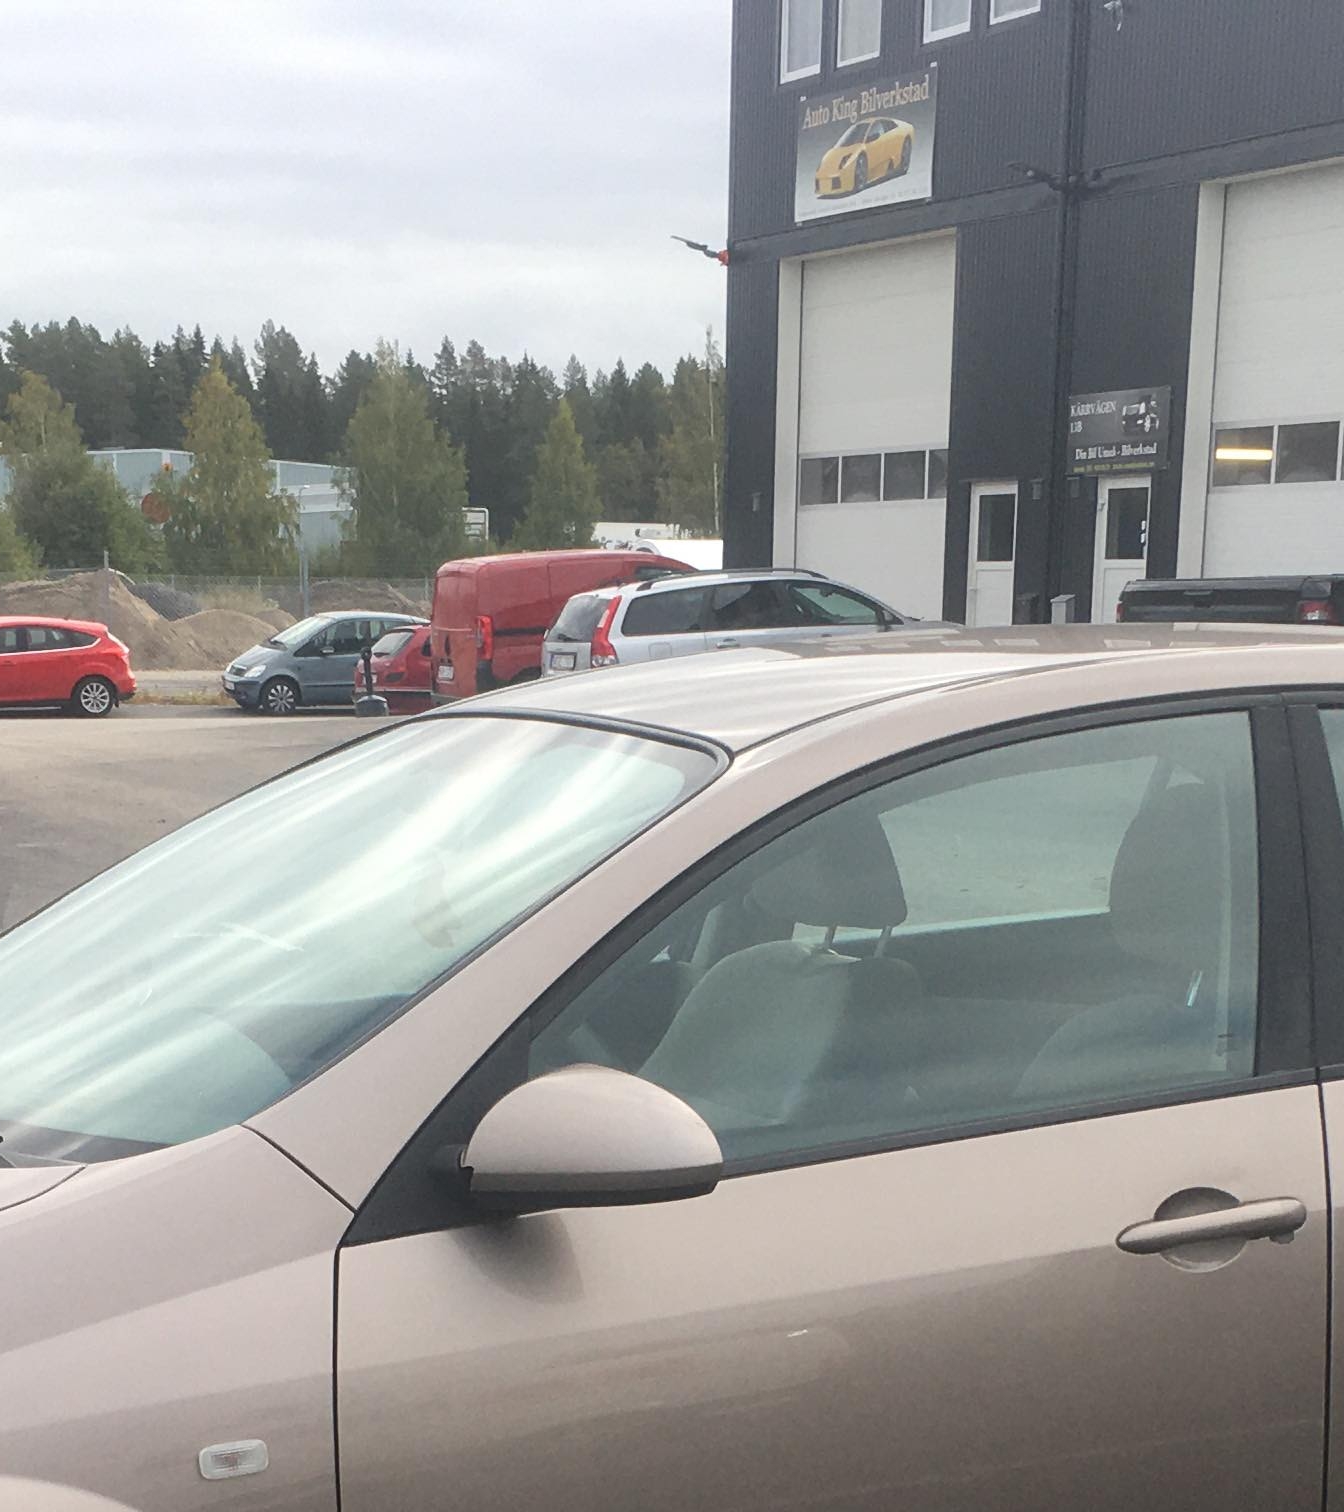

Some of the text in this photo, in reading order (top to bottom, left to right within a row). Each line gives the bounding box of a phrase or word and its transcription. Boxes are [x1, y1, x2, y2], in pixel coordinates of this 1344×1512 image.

[802, 73, 929, 129] Auto King Bilverkstad
